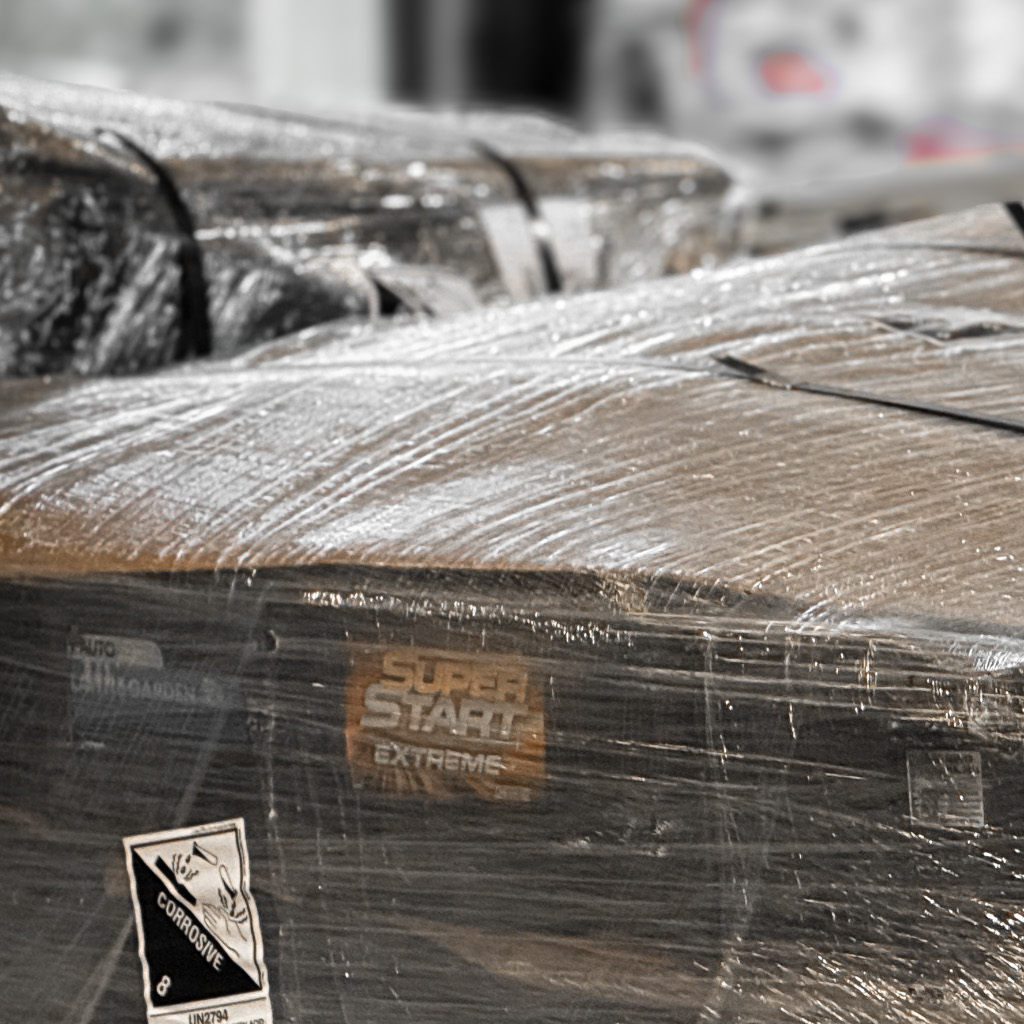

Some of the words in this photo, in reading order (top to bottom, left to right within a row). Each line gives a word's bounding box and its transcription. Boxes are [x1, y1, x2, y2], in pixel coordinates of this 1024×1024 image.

[379, 651, 529, 703] SUPER
[360, 683, 529, 739] START
[374, 743, 506, 776] EXTREME
[156, 891, 224, 972] CORROSIVE
[156, 975, 171, 997] 8
